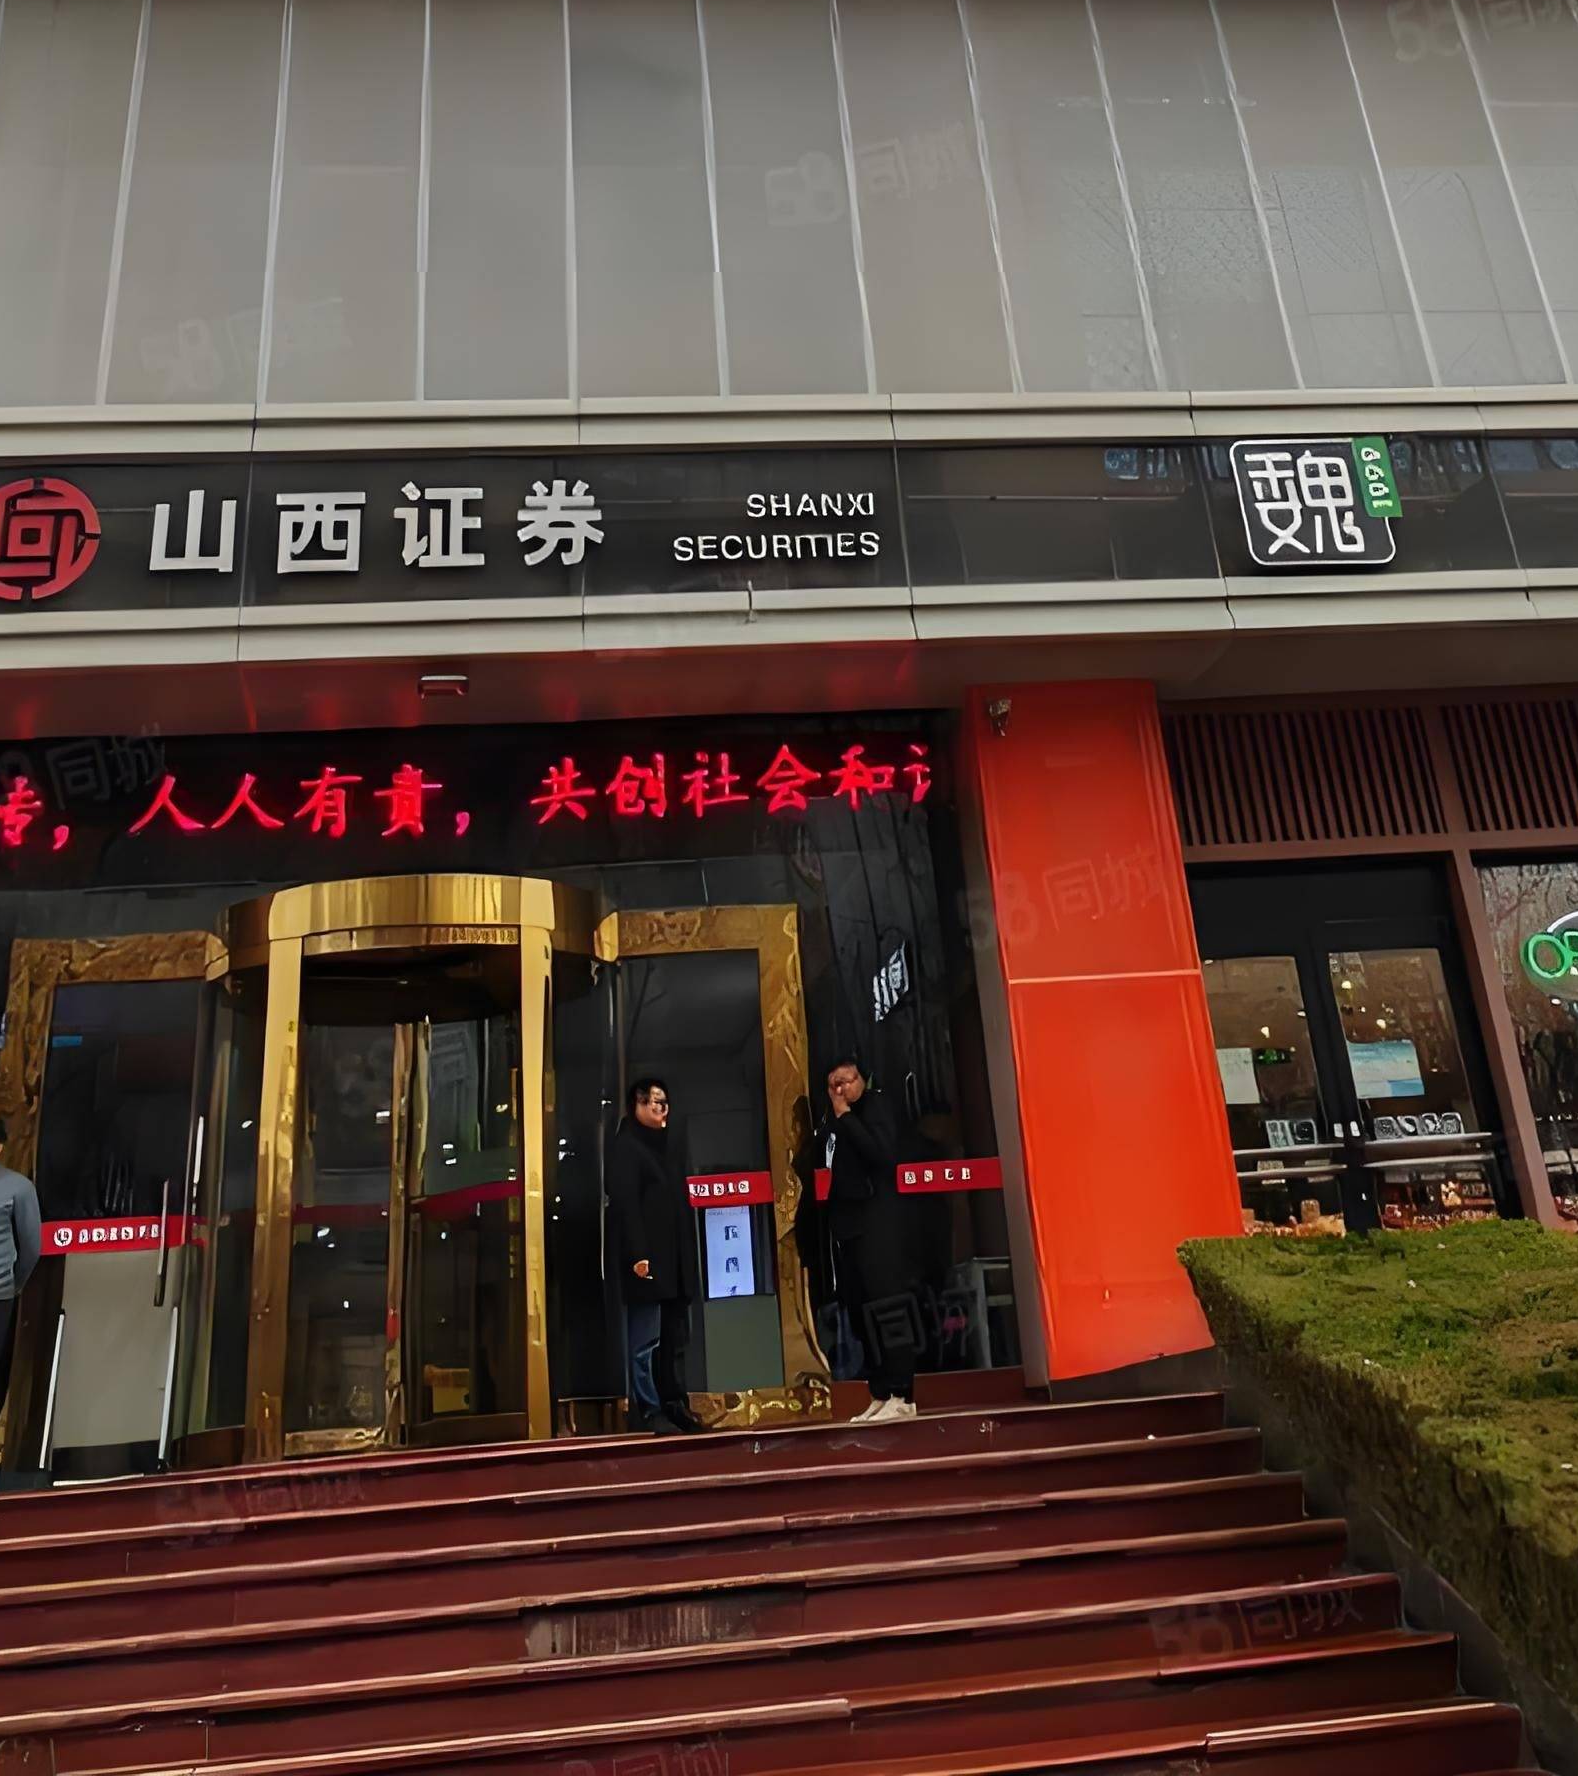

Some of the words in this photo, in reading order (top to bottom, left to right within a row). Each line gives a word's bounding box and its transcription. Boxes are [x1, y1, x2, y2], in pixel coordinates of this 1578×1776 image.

[746, 491, 875, 519] SHANXI
[149, 479, 605, 574] 山西证券
[672, 531, 881, 562] SECURITIES
